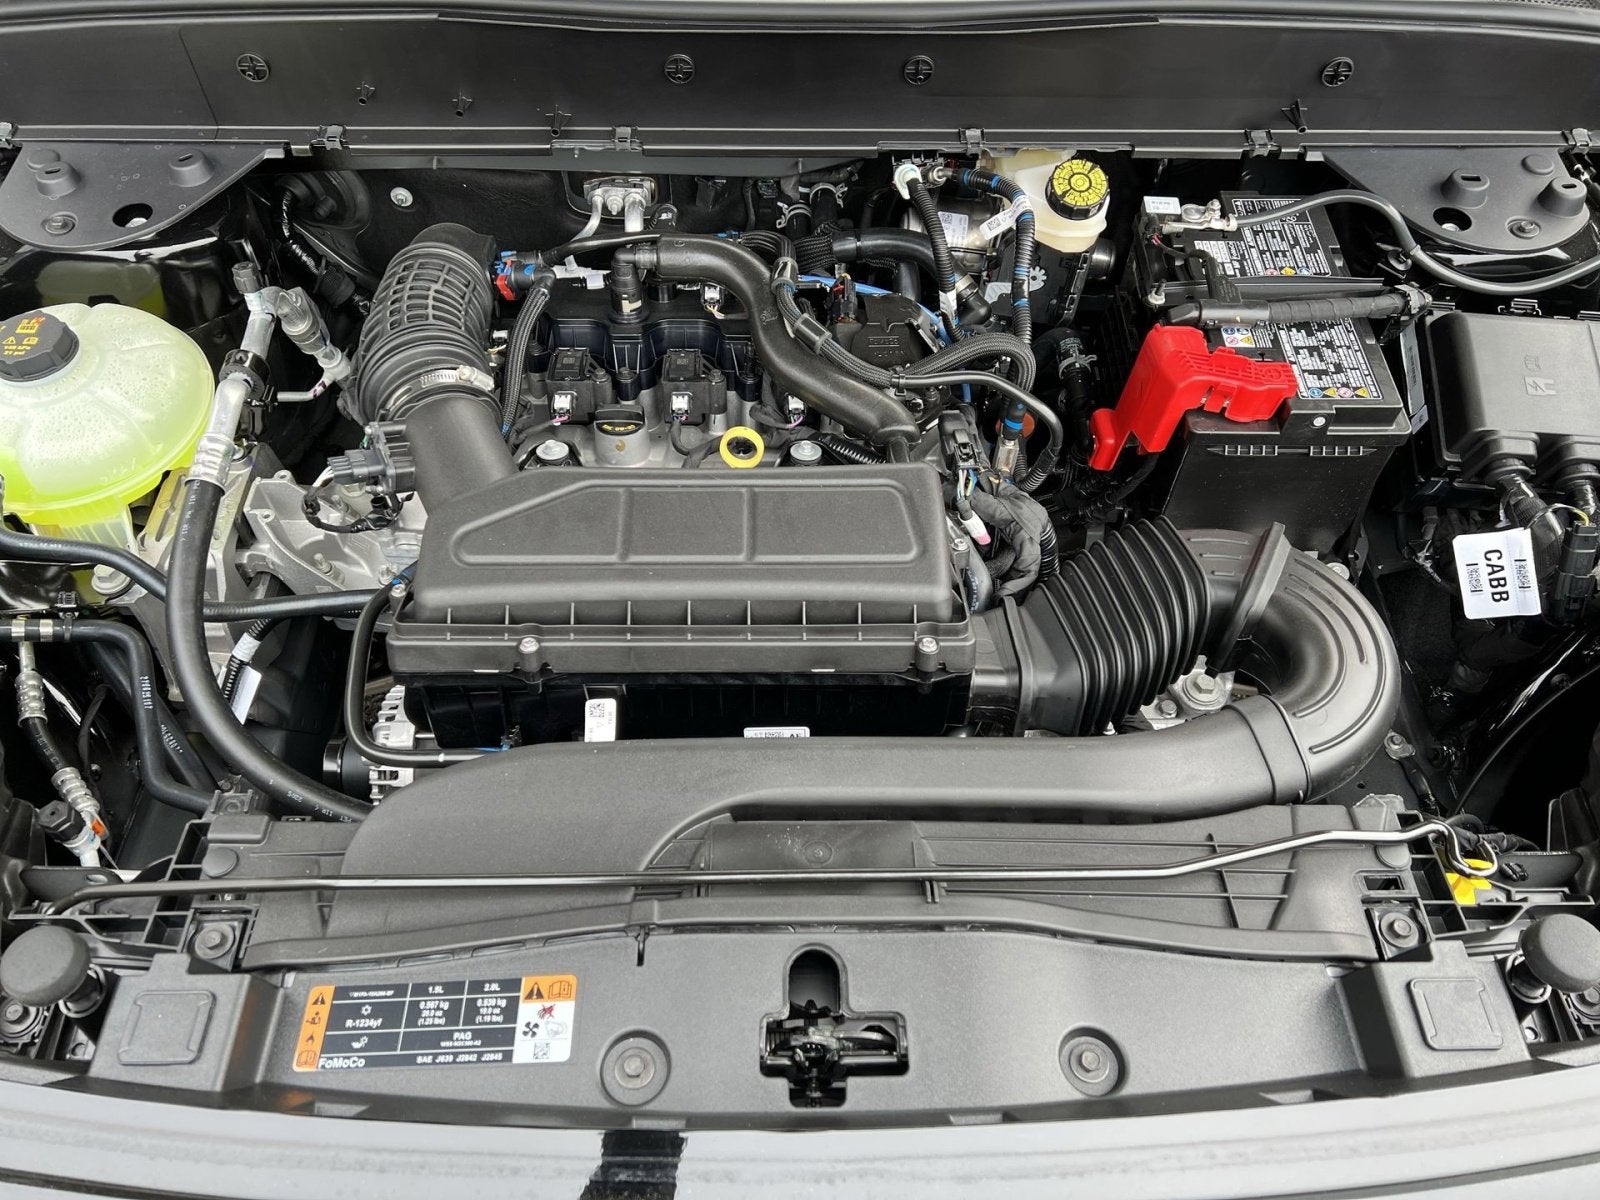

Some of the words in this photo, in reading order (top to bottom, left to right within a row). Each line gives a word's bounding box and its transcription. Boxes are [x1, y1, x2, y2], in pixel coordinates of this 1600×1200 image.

[1484, 549, 1510, 603] CABB
[439, 1000, 450, 1011] kg
[345, 1018, 383, 1029] R-1234yf
[453, 1031, 473, 1041] PAG
[318, 1056, 366, 1069] FoMoCo
